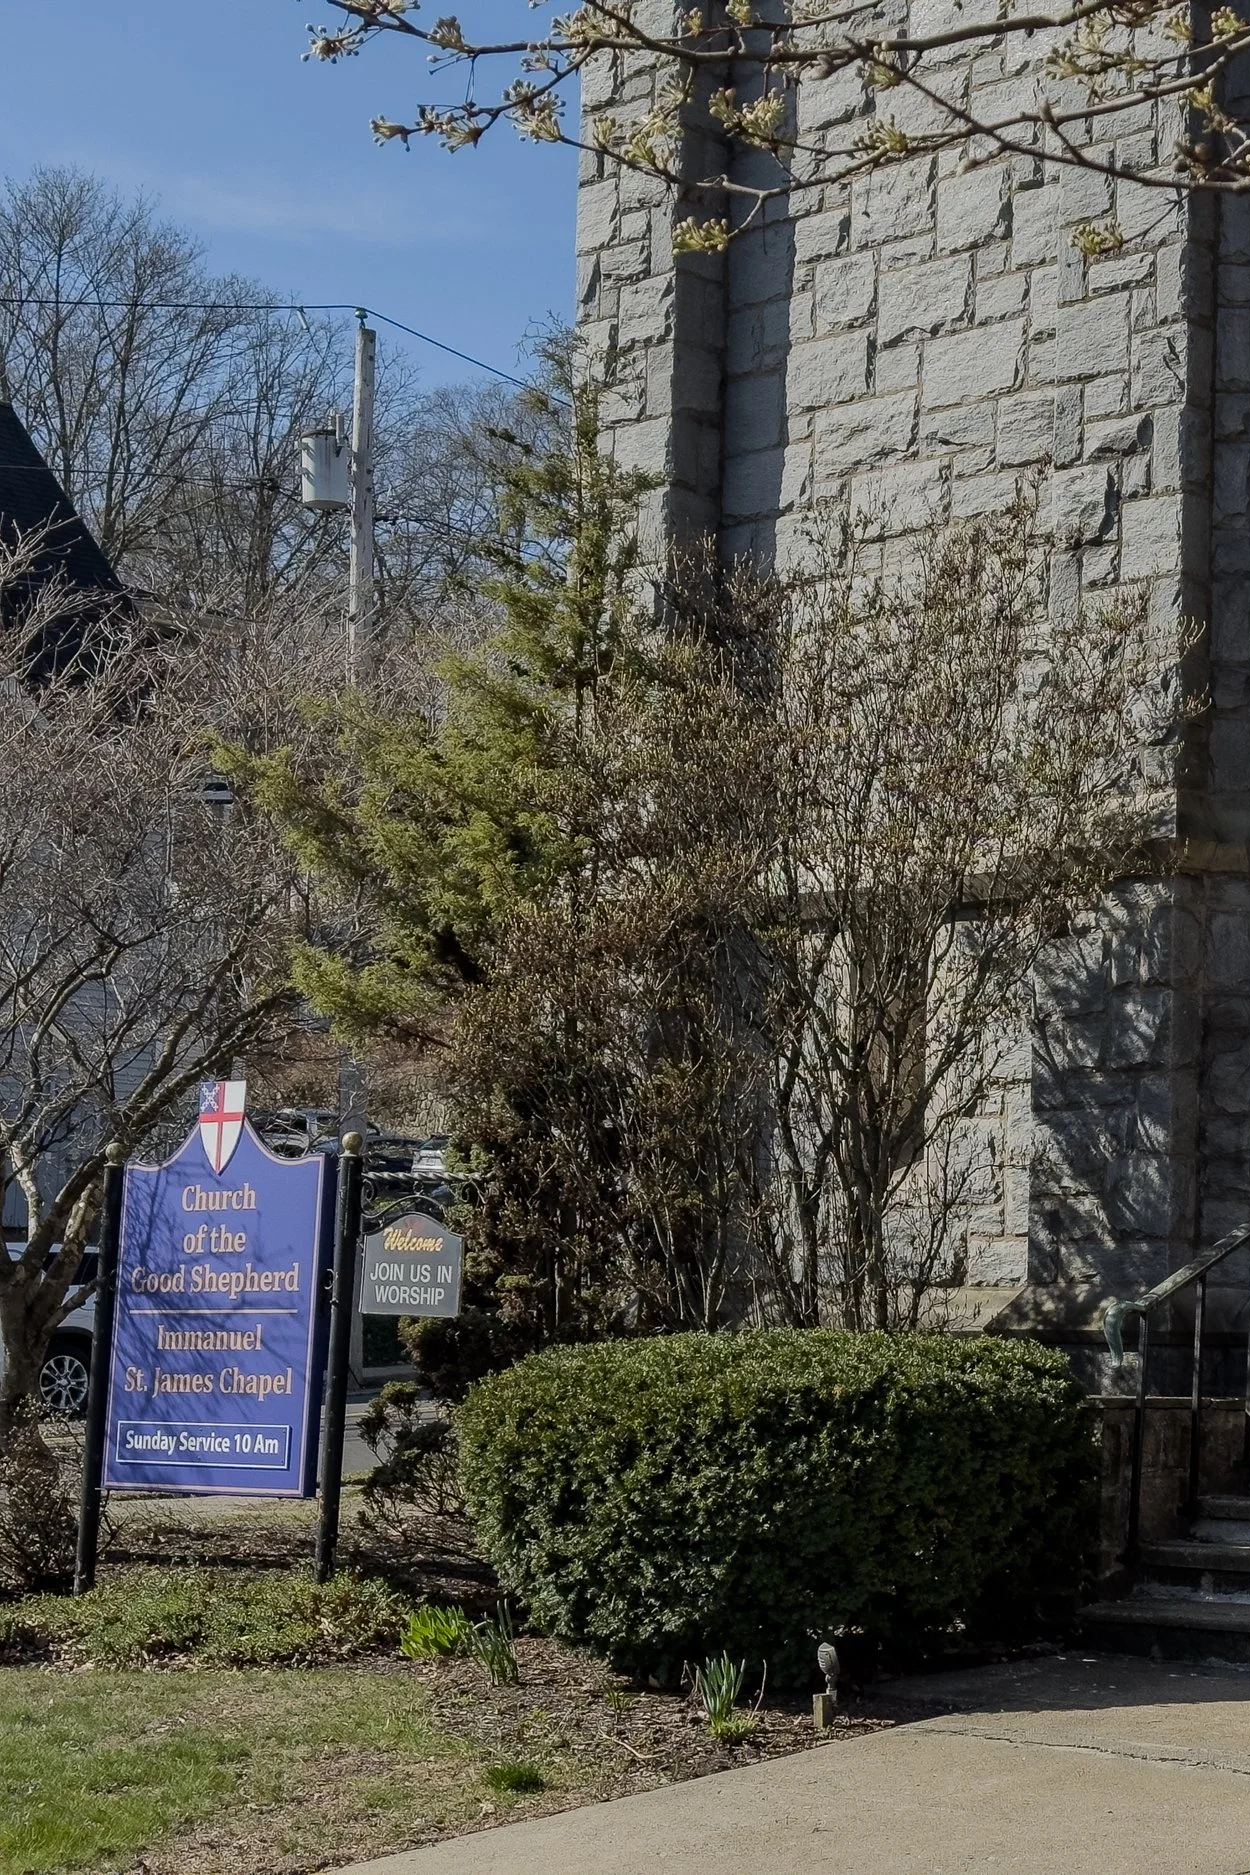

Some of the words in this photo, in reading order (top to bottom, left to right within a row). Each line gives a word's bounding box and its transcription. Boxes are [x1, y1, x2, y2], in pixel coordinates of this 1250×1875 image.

[182, 1183, 256, 1211] Church
[183, 1224, 208, 1253] of
[210, 1224, 246, 1253] the
[382, 1227, 444, 1252] Welcome
[131, 1265, 185, 1293] Good
[190, 1263, 299, 1299] Shepherd
[370, 1263, 404, 1281] JOIN
[410, 1264, 431, 1283] US
[437, 1265, 452, 1283] IN
[375, 1285, 445, 1305] WORSHIP
[157, 1324, 262, 1350] Immanuel
[124, 1366, 148, 1392] St.
[152, 1367, 213, 1398] James
[219, 1367, 292, 1401] Chapel
[126, 1430, 177, 1455] Sunday
[179, 1432, 230, 1453] Service
[234, 1434, 250, 1453] 10
[253, 1434, 278, 1454] Am
